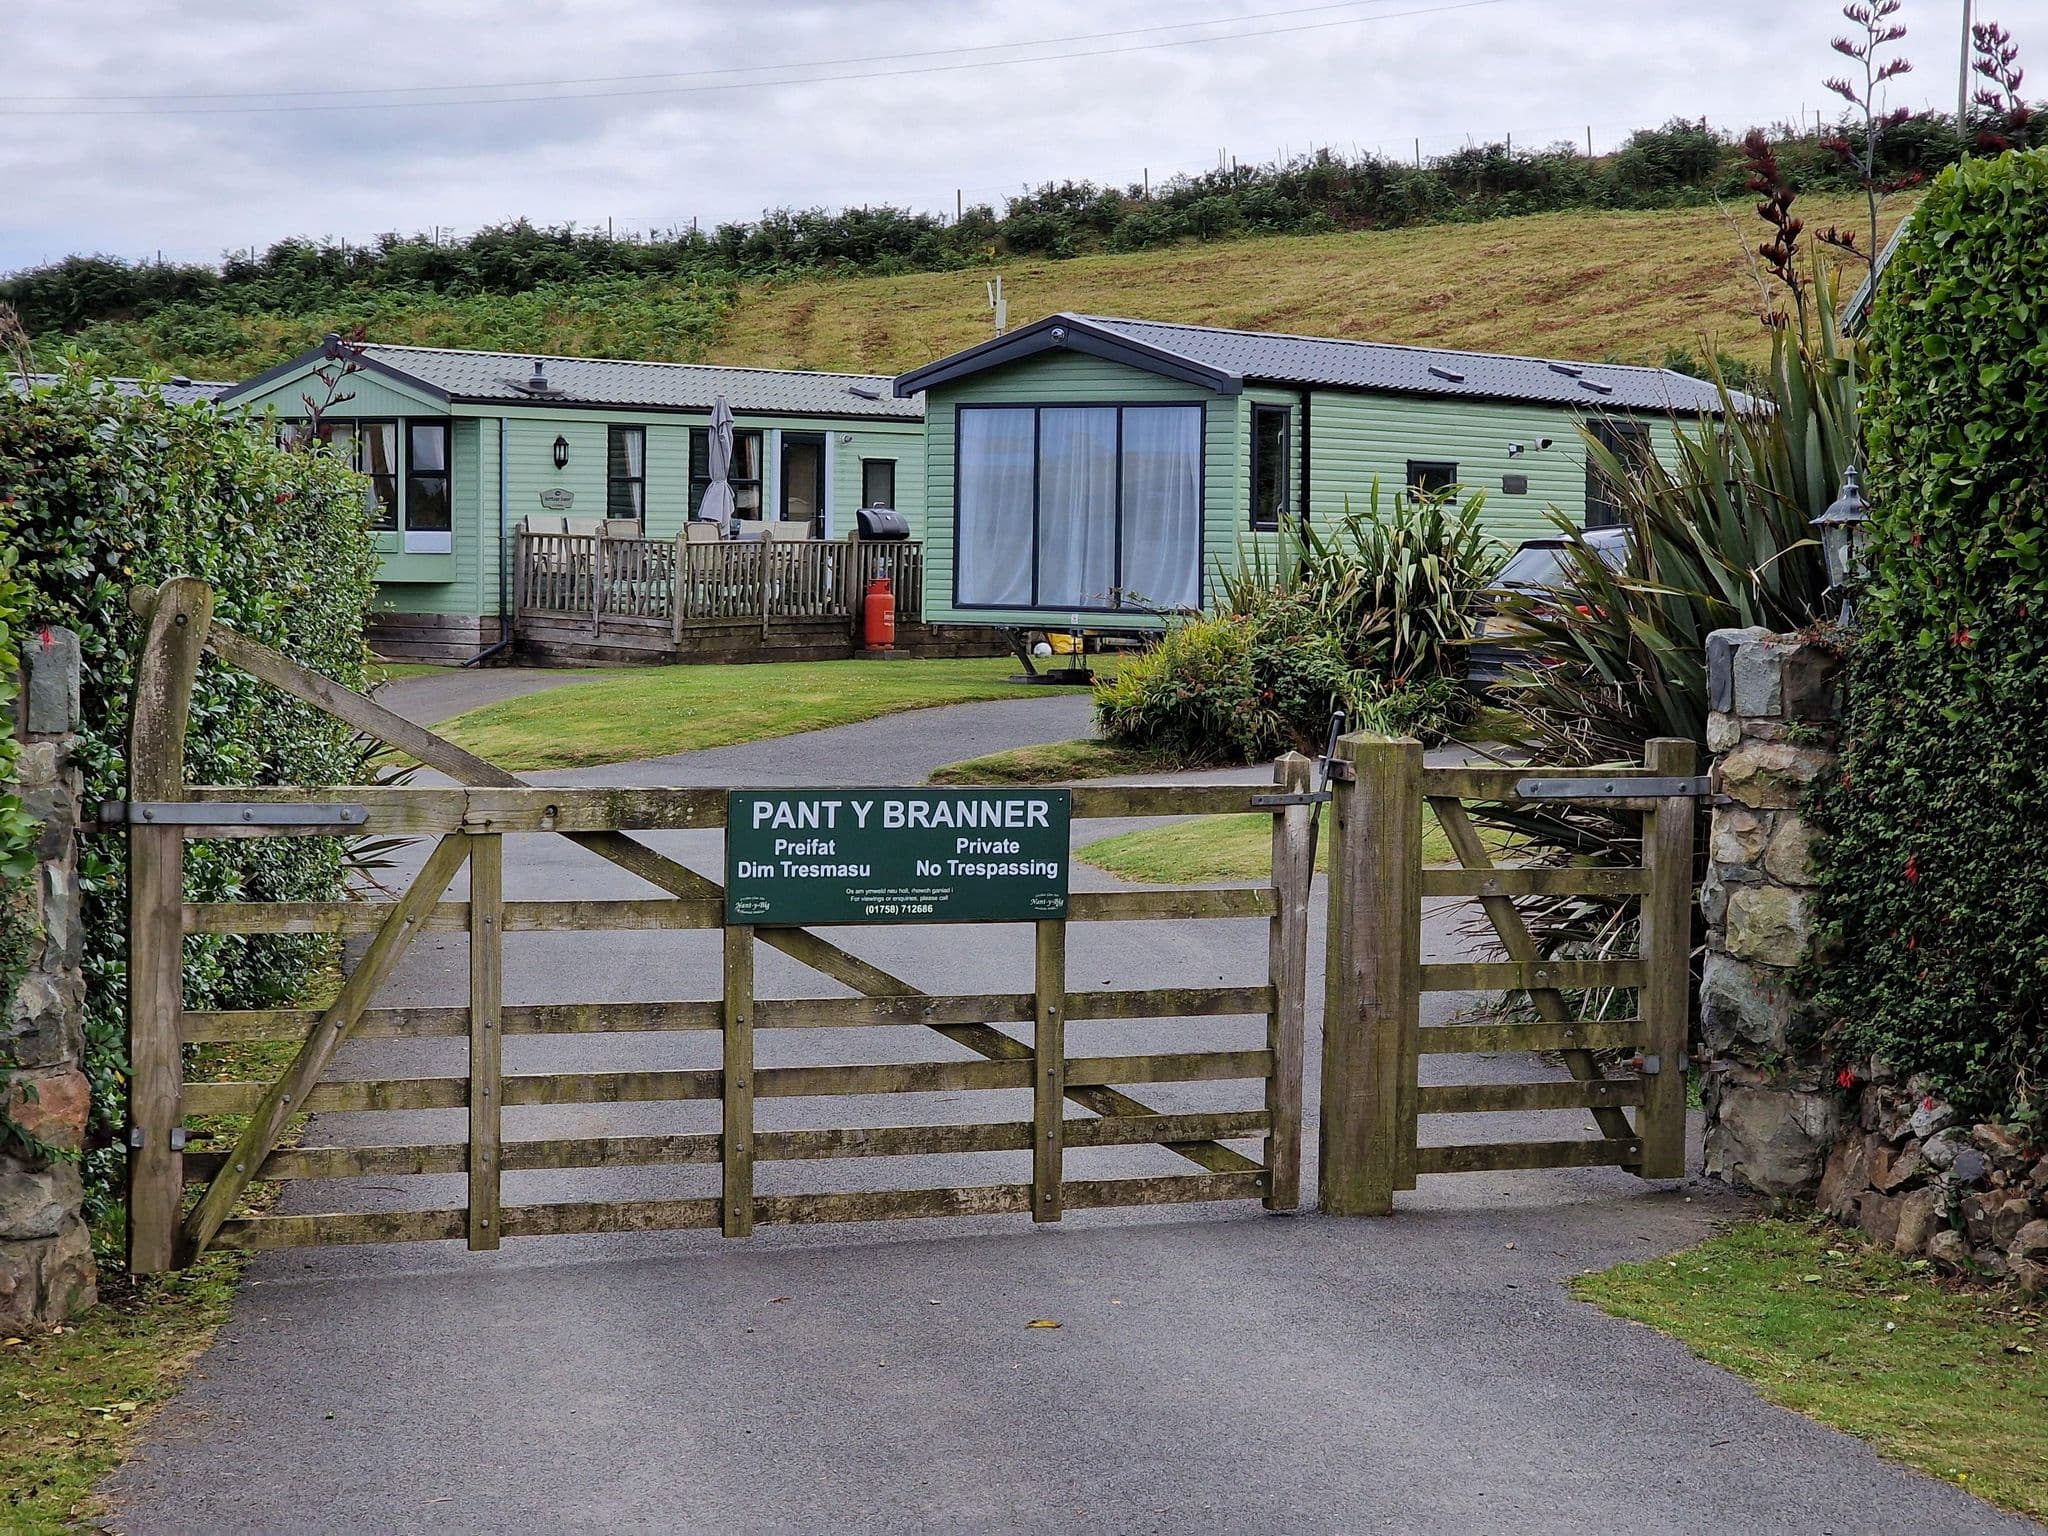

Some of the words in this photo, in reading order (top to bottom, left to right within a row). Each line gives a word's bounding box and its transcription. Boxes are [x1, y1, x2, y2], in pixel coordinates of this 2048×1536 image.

[753, 801, 842, 829] PANT
[851, 801, 874, 828] Y
[883, 800, 1050, 828] BRANNER
[774, 838, 836, 856] Preifat
[956, 837, 1020, 854] Private
[738, 861, 774, 878] Dim
[780, 861, 871, 878] Tresmasu
[916, 860, 942, 877] No
[947, 859, 1058, 880] Trespassing
[865, 904, 899, 916] (01758)
[901, 904, 933, 914] 712686
